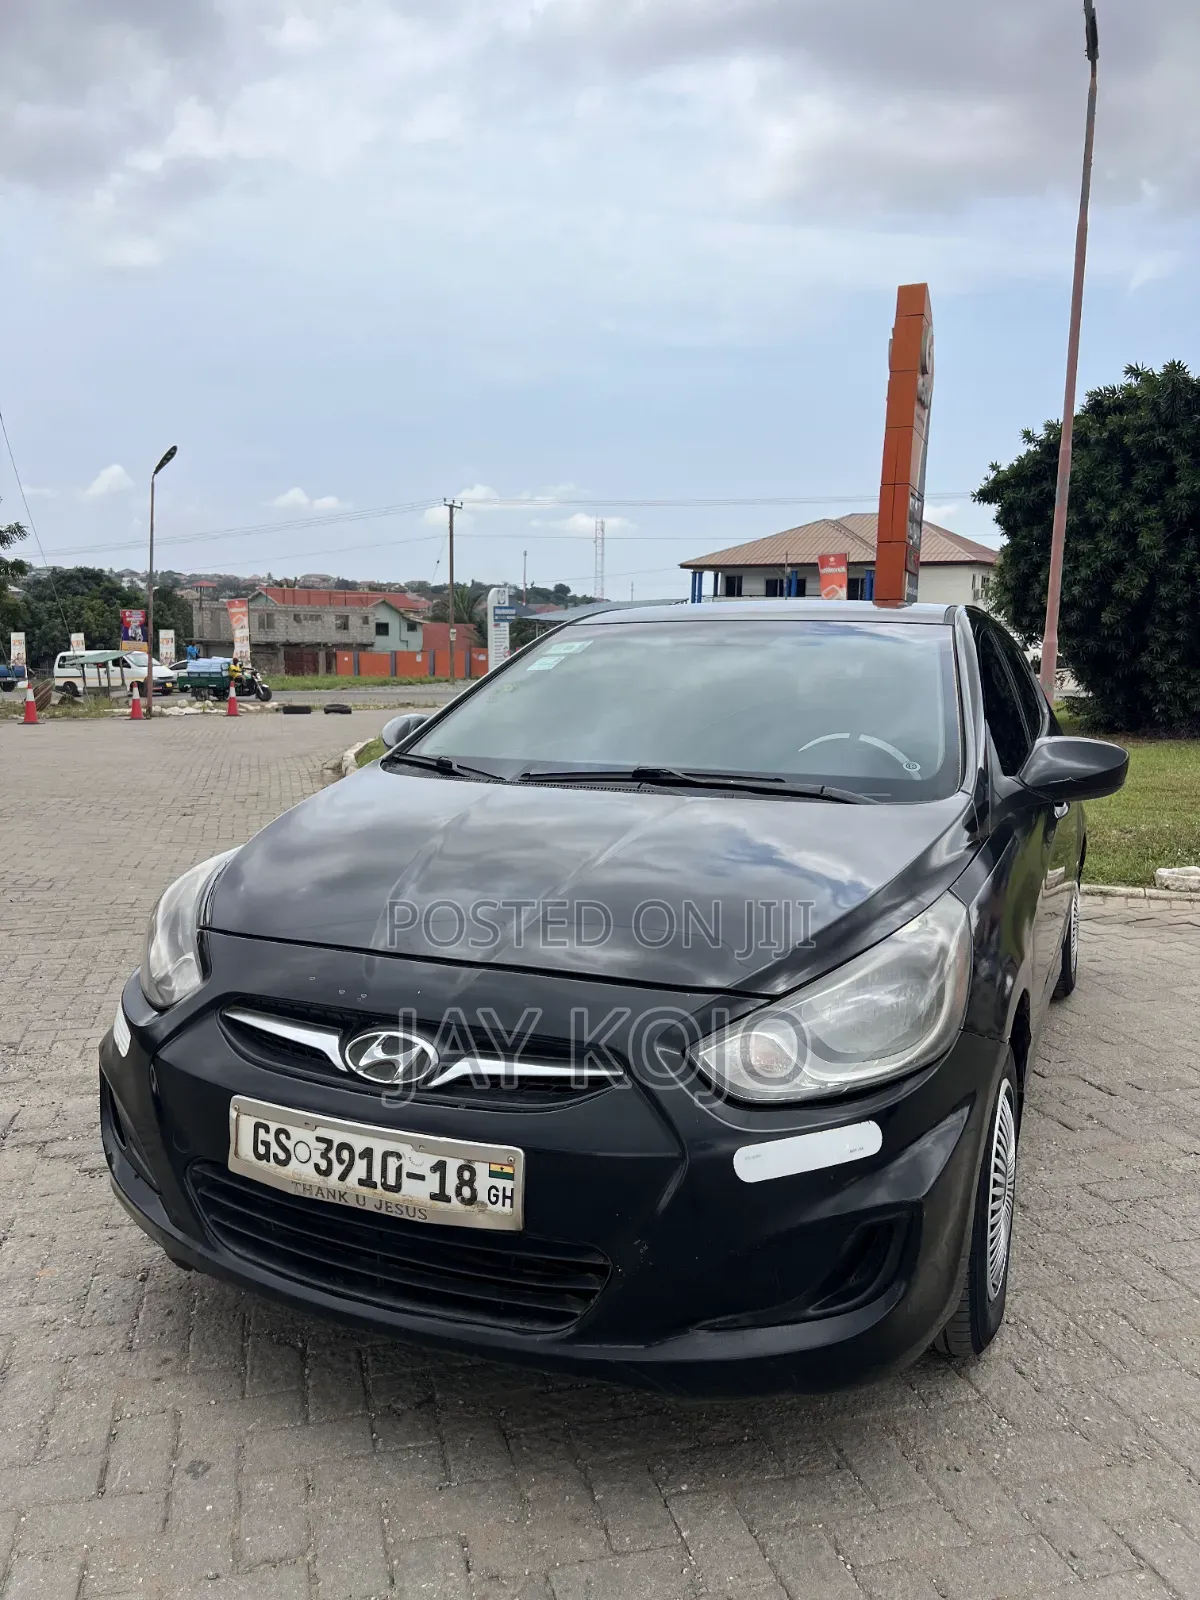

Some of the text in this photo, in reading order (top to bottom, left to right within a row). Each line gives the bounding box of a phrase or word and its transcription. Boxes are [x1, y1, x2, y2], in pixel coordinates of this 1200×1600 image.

[253, 1121, 478, 1207] GS 3910-18
[291, 1181, 428, 1221] THANK U JESUS
[487, 1184, 515, 1209] GH
